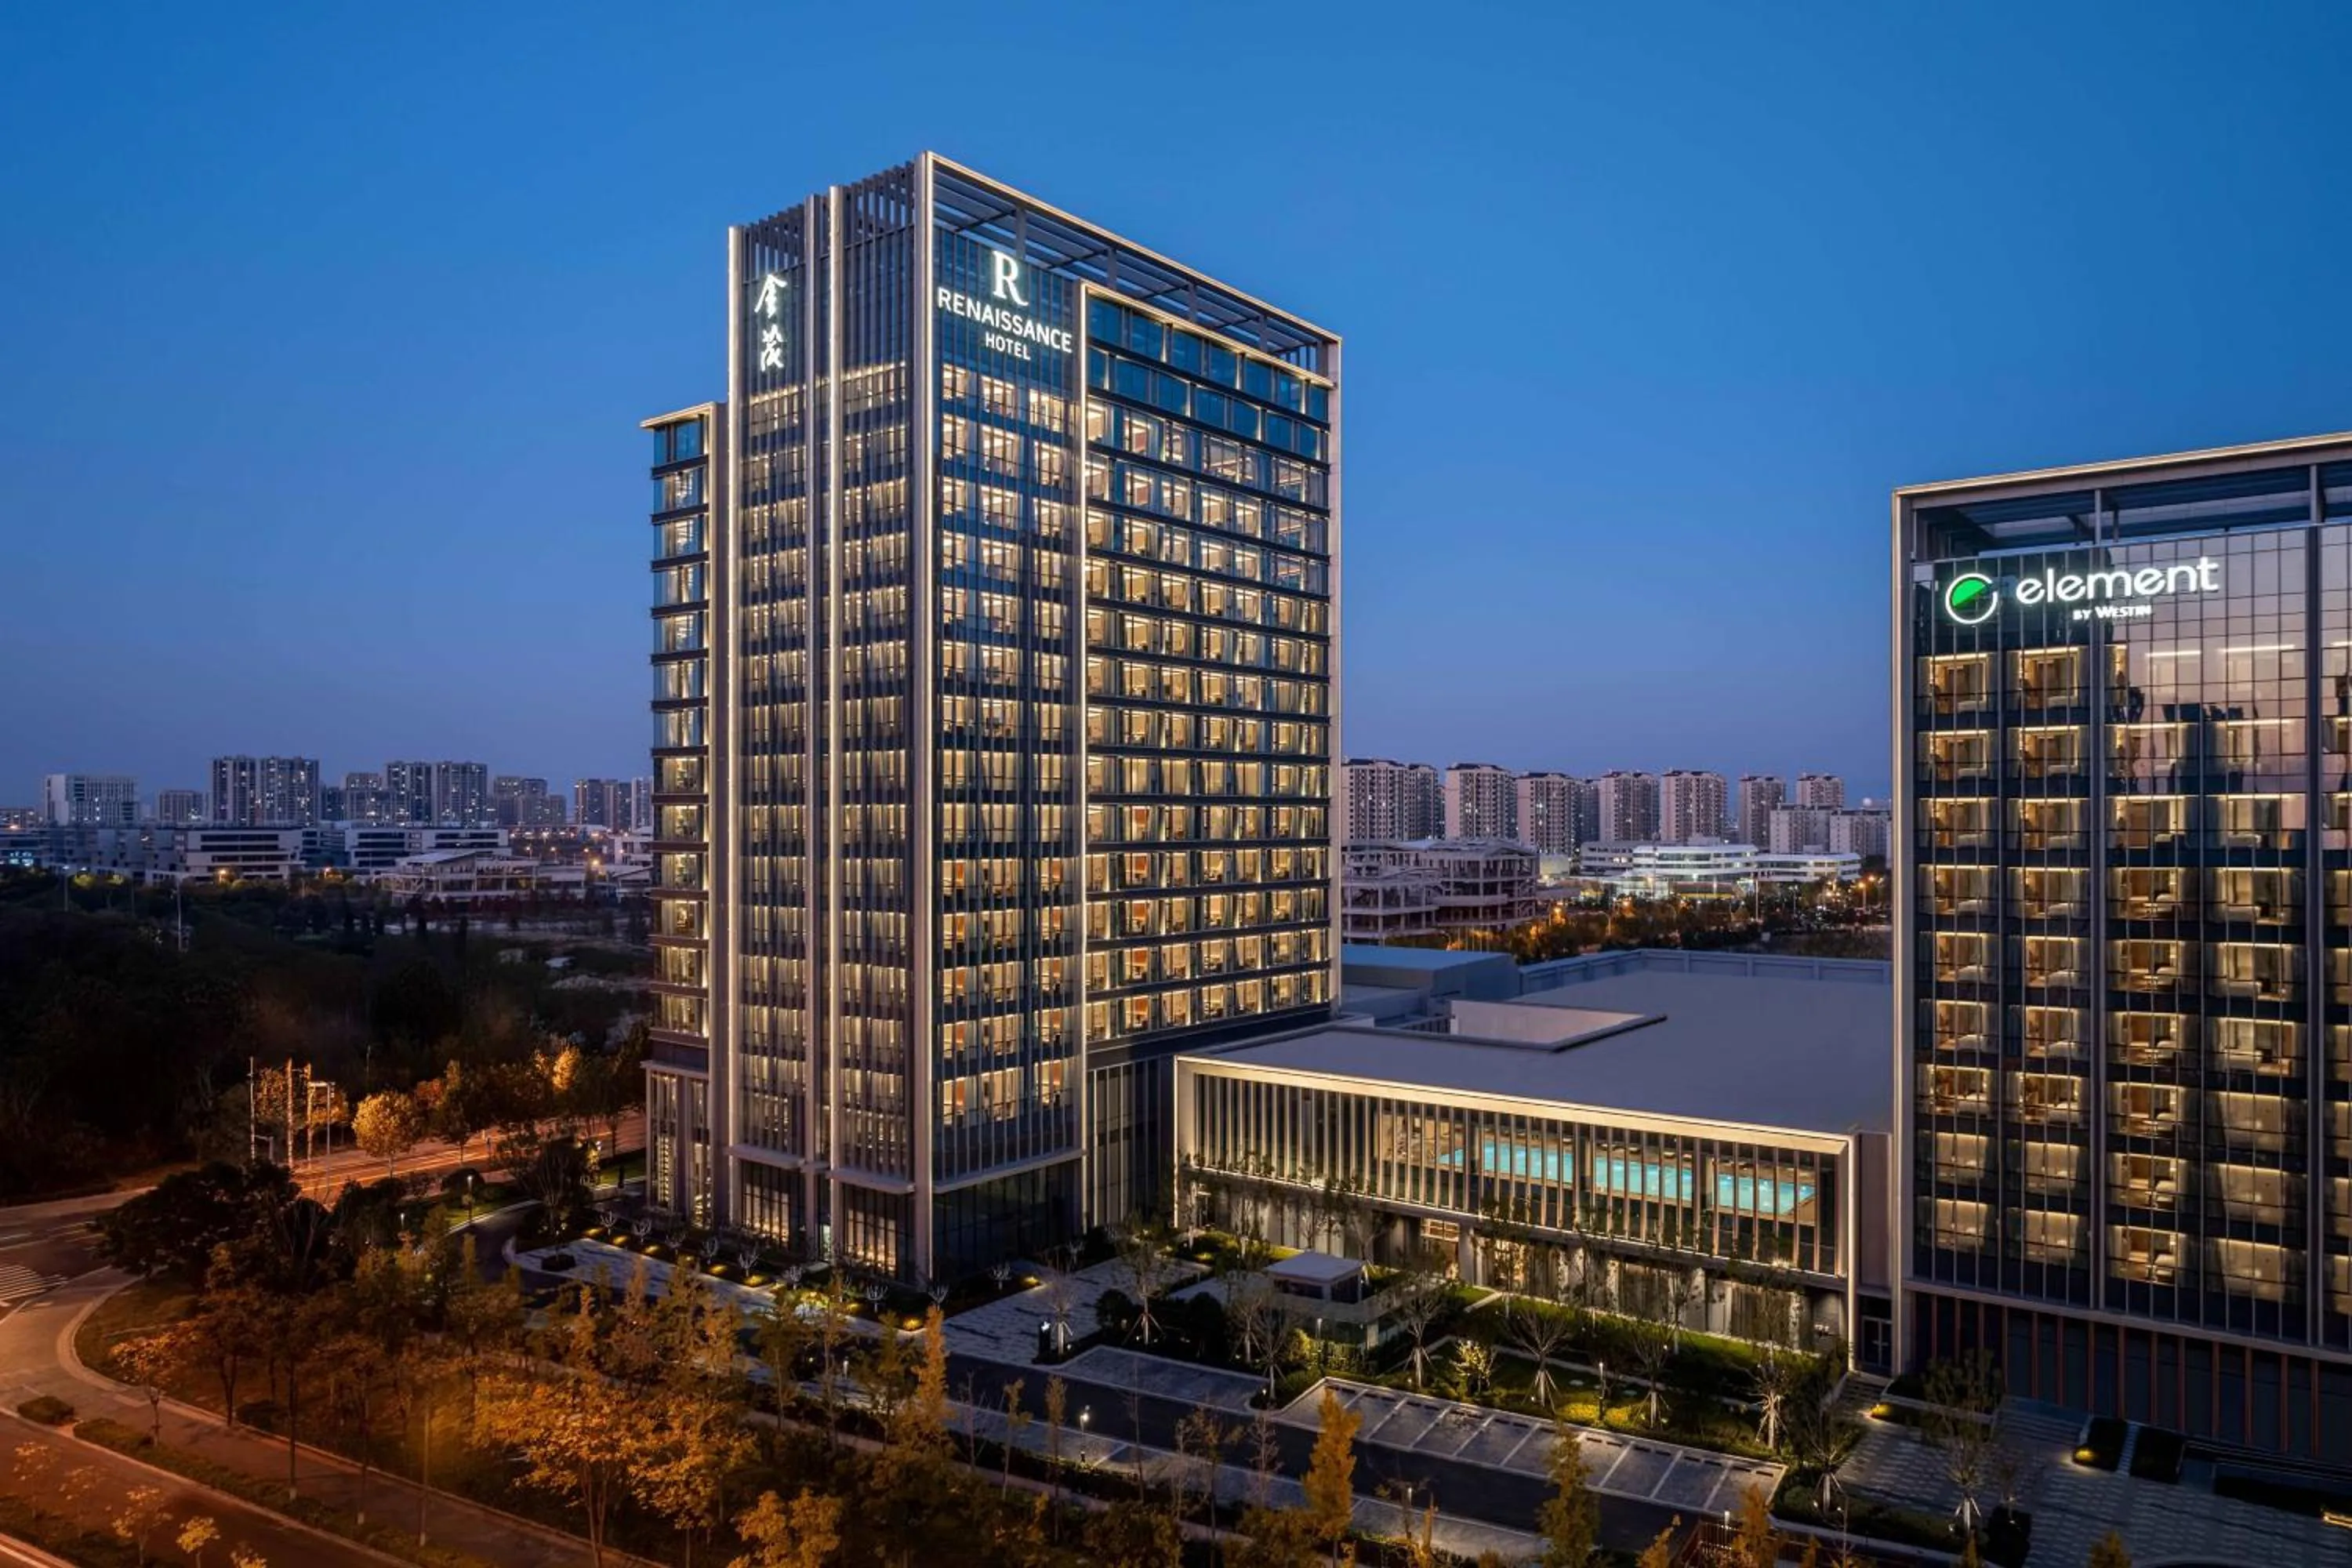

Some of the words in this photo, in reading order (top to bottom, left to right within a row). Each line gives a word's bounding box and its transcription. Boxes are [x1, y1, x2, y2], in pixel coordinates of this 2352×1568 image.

[993, 250, 1029, 306] R
[938, 286, 1073, 354] RENAISSANCE
[985, 332, 1031, 361] HOTEL
[2016, 556, 2219, 604] element
[2072, 609, 2092, 620] BY
